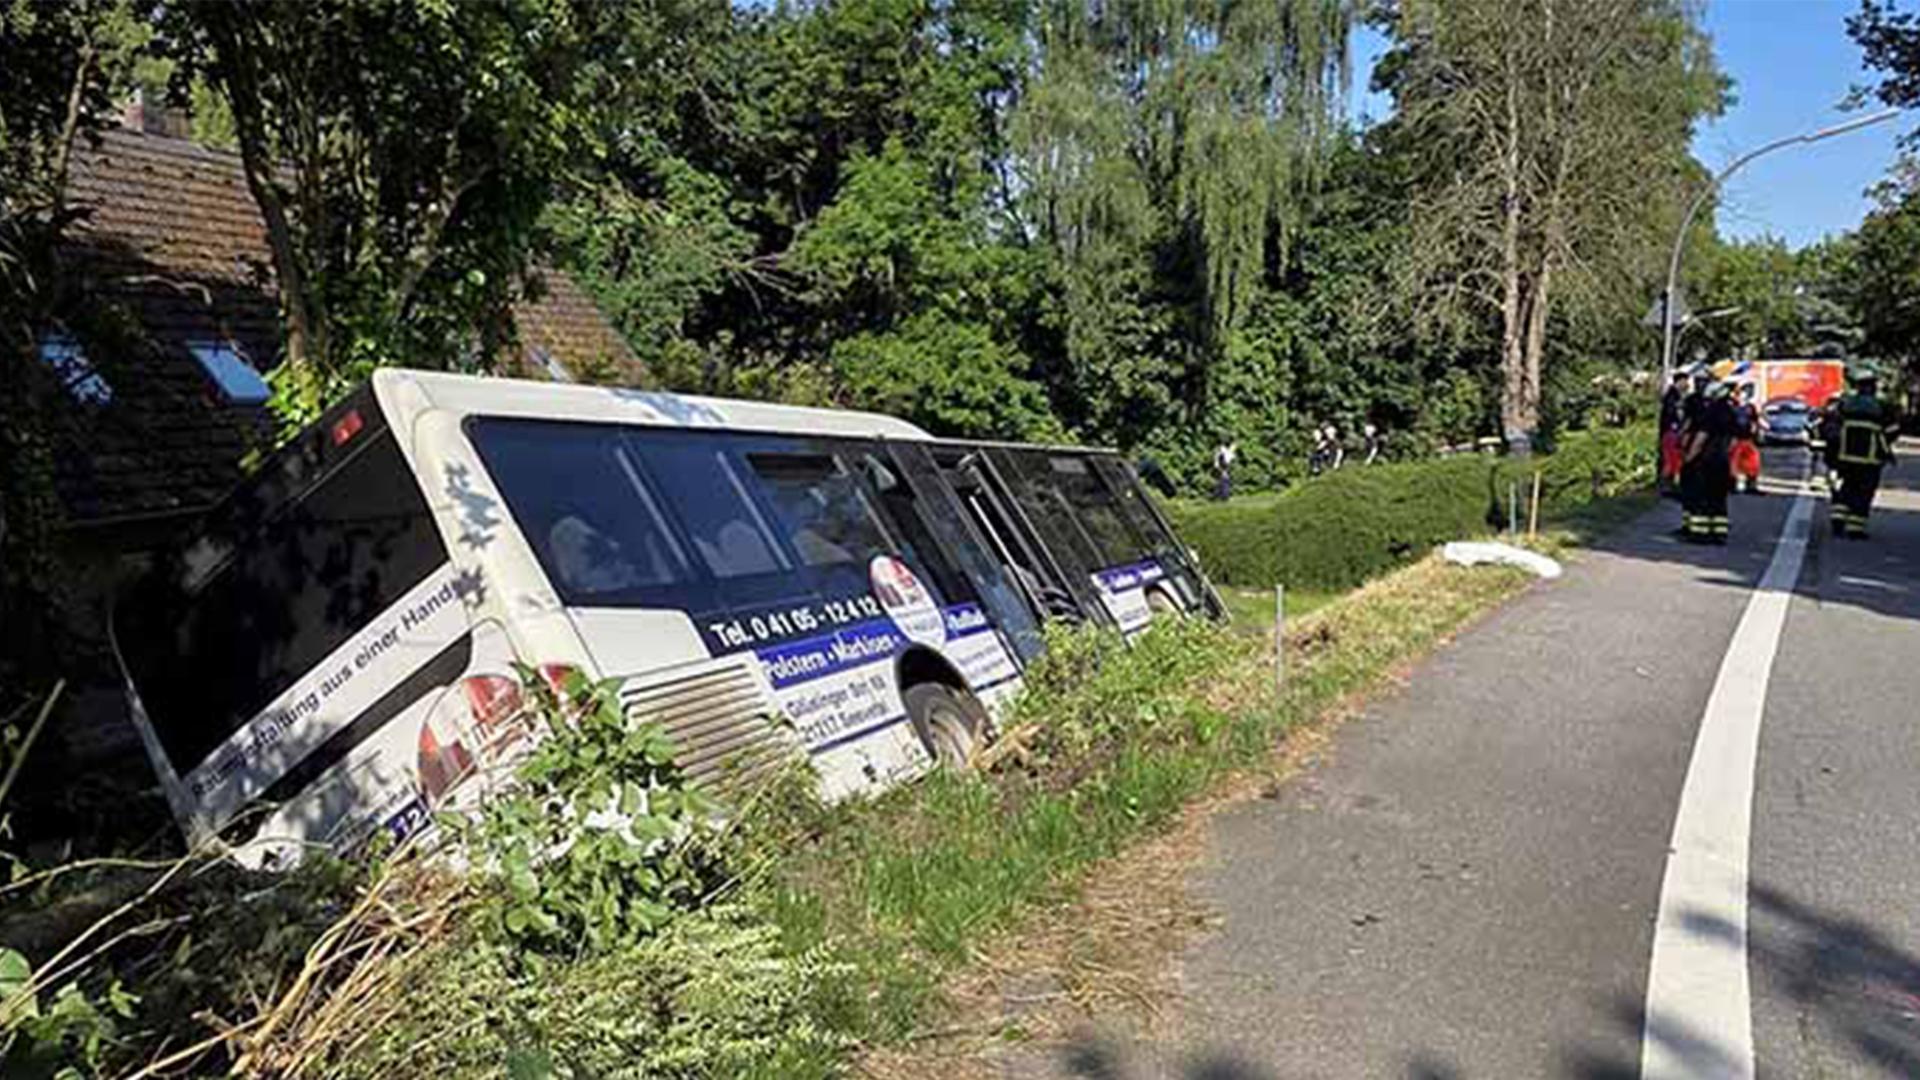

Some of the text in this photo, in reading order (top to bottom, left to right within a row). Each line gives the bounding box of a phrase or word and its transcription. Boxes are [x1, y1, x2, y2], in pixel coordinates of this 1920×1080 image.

[751, 616, 770, 640] 0
[768, 612, 794, 635] 41
[791, 607, 818, 632] 05
[320, 665, 353, 697] aus
[354, 625, 399, 669] einer
